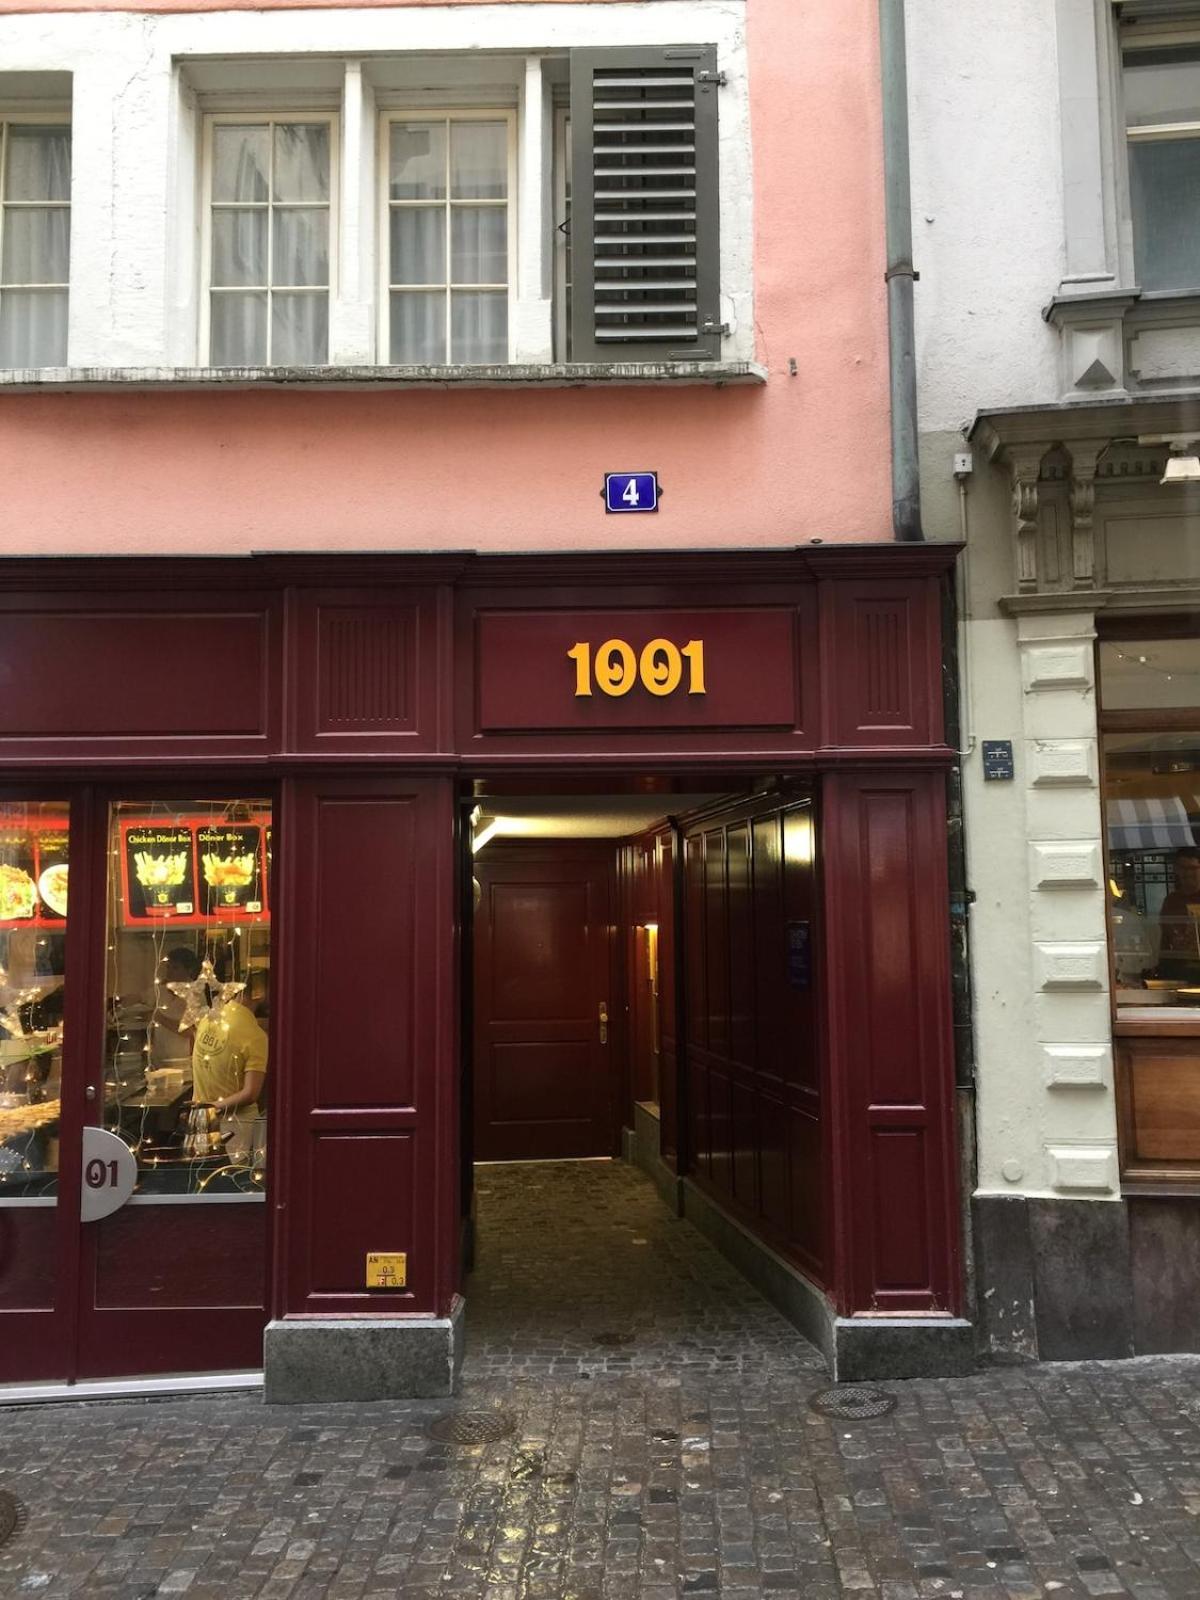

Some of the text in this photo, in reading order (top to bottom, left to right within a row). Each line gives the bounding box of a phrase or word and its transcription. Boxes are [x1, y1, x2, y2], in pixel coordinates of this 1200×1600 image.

[622, 478, 640, 506] 4
[567, 638, 707, 698] 1001
[128, 834, 156, 843] Chicken
[178, 834, 192, 843] Box
[226, 833, 244, 841] Box
[85, 1158, 119, 1189] 01
